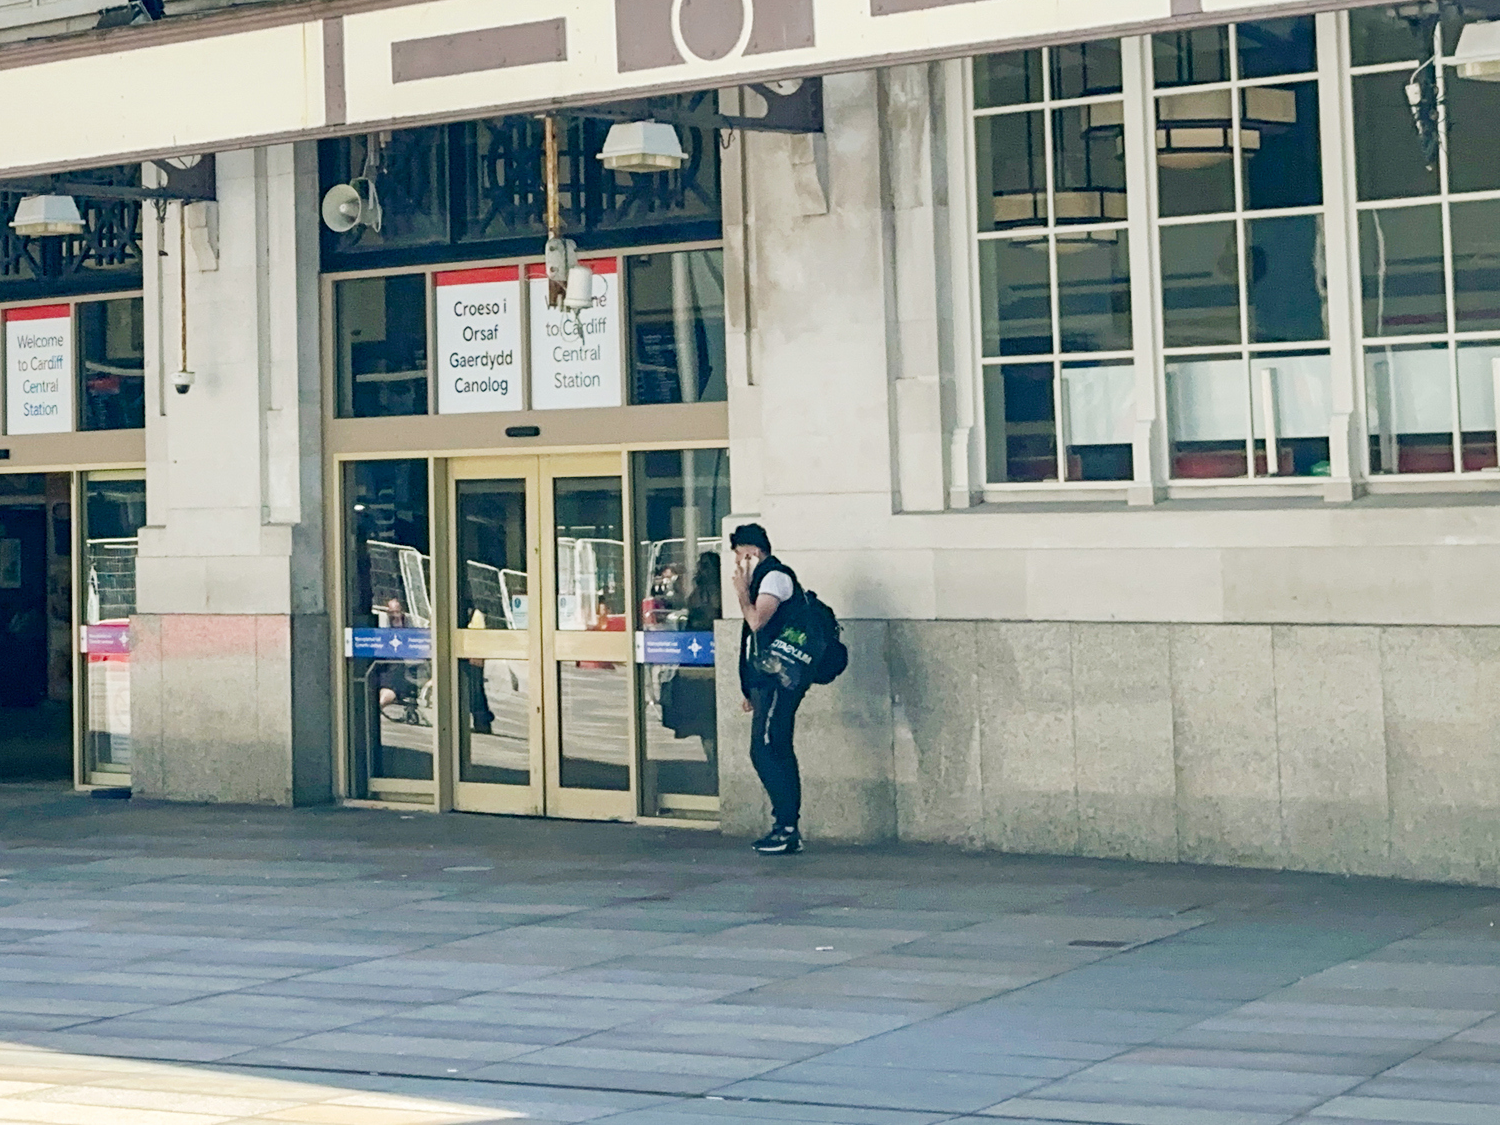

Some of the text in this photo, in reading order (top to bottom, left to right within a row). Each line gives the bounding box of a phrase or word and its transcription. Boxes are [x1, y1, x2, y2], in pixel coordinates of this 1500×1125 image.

[453, 298, 507, 317] Croeso i
[462, 324, 499, 342] Orsaf
[545, 322, 560, 337] to
[17, 335, 64, 349] Welcome
[449, 349, 513, 370] Gaerdydd
[553, 344, 601, 363] Central
[18, 355, 64, 372] to Cardiff
[23, 378, 59, 394] Central
[454, 377, 509, 396] Canolog
[554, 371, 601, 389] Station
[23, 402, 58, 417] Station
